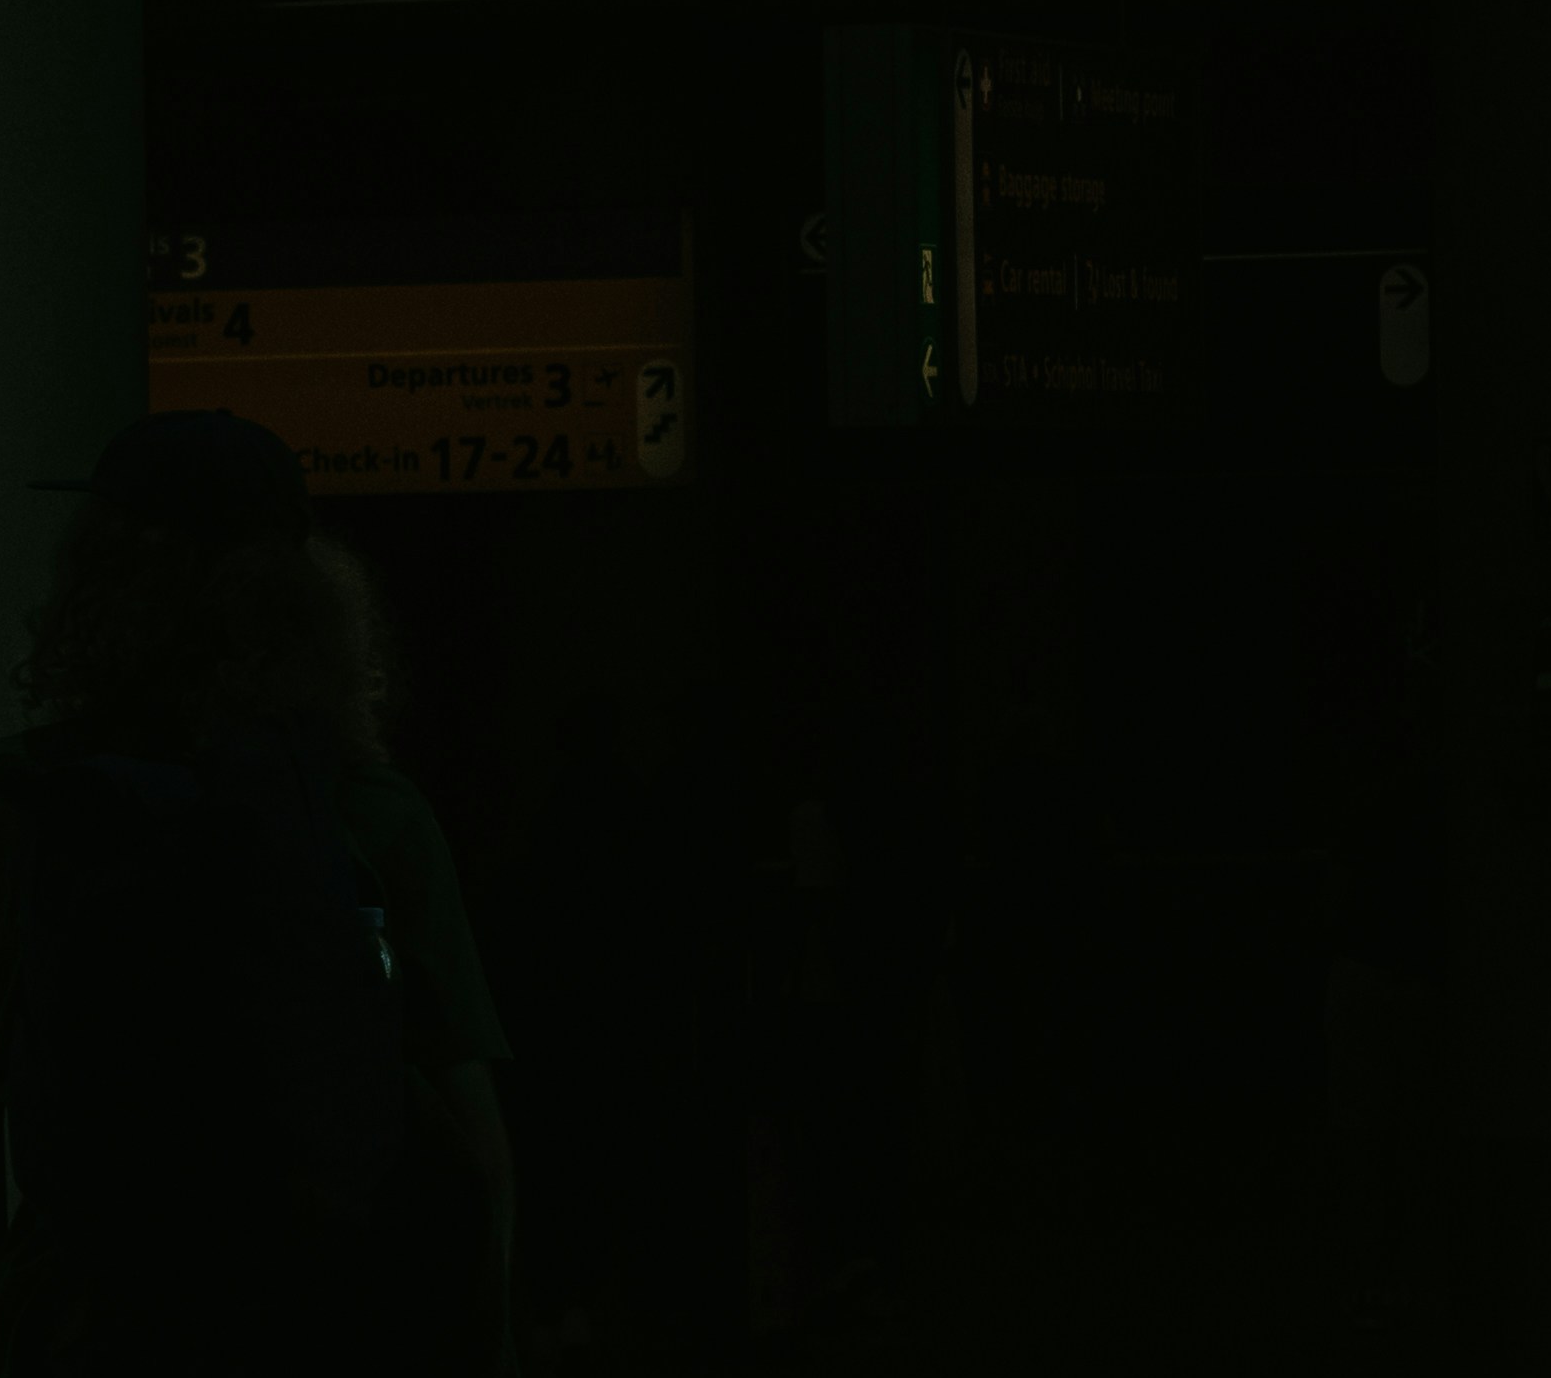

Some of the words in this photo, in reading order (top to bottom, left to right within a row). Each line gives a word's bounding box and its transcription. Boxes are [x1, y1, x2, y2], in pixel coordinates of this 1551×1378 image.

[998, 163, 1058, 210] Baggage
[1060, 172, 1106, 213] storage
[179, 235, 208, 280] 3
[999, 258, 1024, 294] Car
[1027, 261, 1067, 297] rental
[222, 302, 256, 347] 4
[367, 363, 534, 395] Departures
[543, 362, 573, 409] 3
[296, 445, 421, 475] Check-in
[431, 433, 575, 482] 17-24
